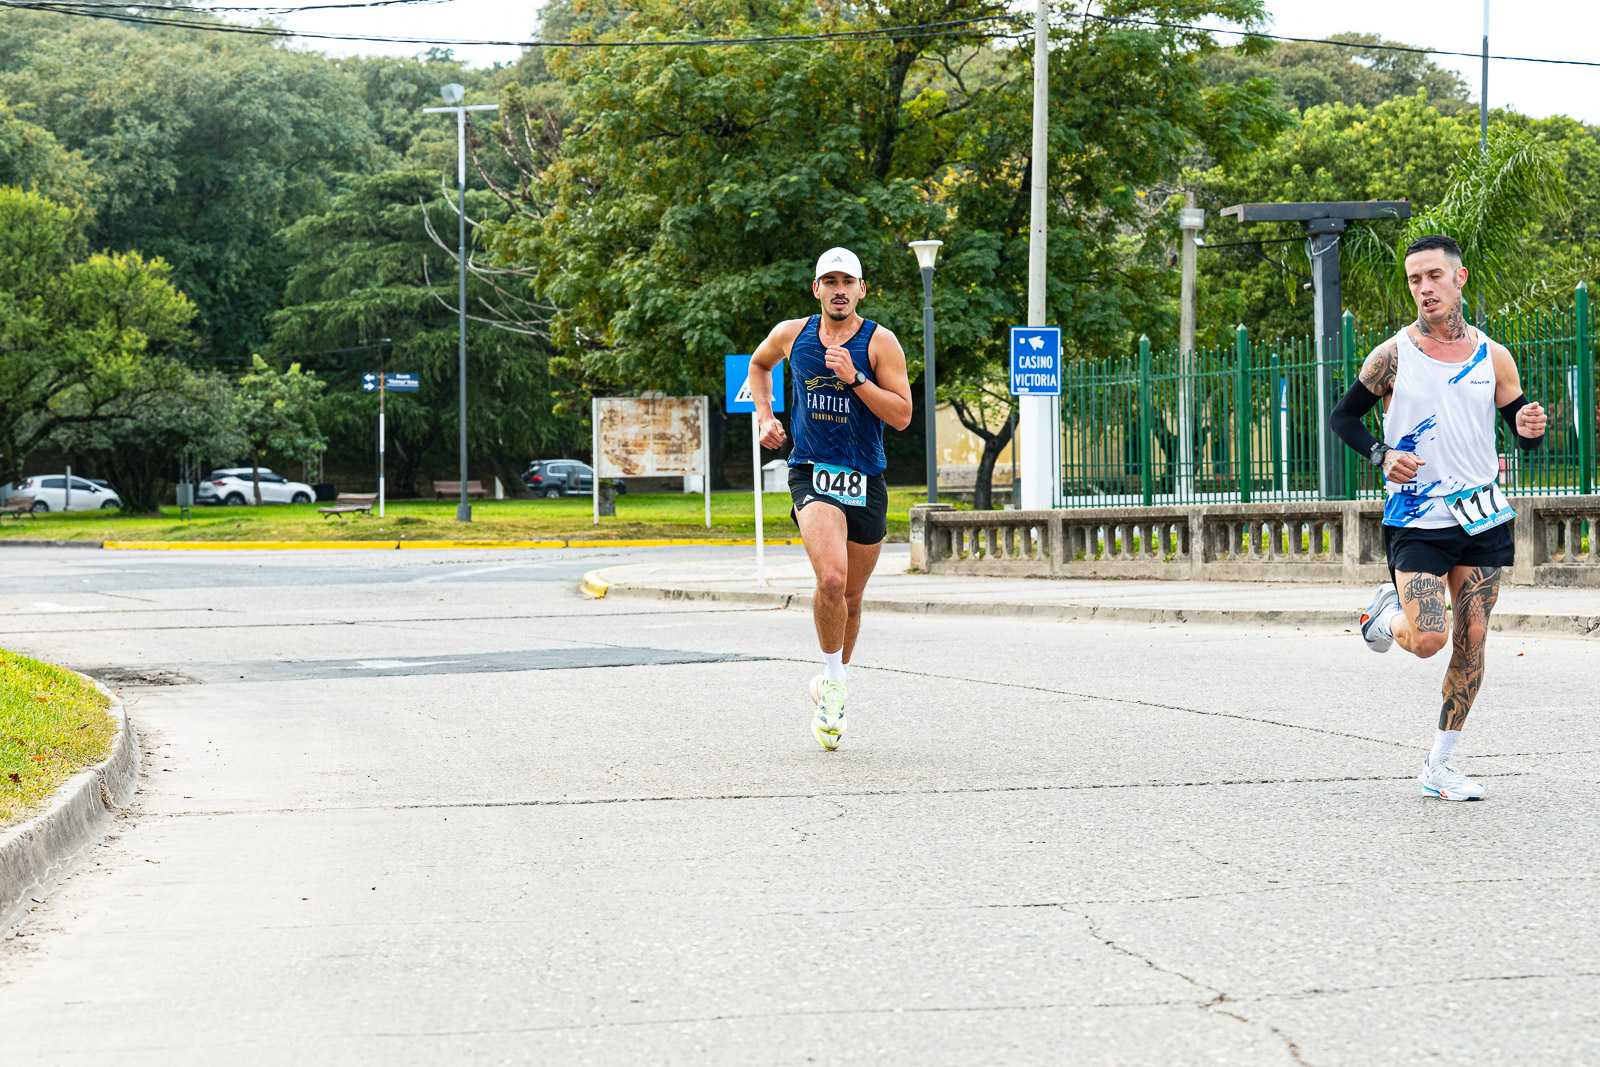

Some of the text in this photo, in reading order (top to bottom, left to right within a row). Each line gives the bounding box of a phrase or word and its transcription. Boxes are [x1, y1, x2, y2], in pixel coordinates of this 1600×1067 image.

[1019, 355, 1053, 369] CASINO
[1015, 373, 1057, 387] VICTORIA
[807, 392, 850, 413] FARTLEK
[815, 469, 862, 498] 048
[1453, 483, 1500, 525] 117
[1469, 511, 1513, 534] DIAMANTE CORRE
